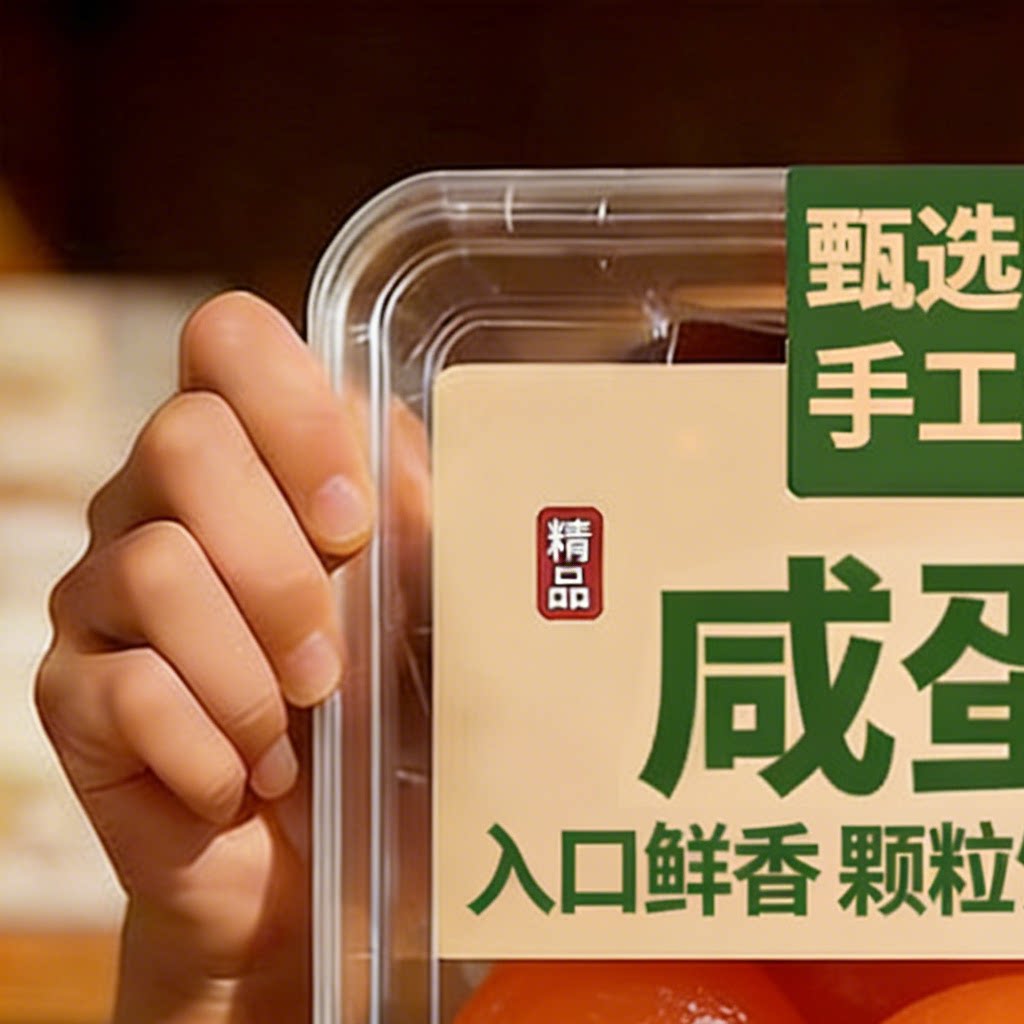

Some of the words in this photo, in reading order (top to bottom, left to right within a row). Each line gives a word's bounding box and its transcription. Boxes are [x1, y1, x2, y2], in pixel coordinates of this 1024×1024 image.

[546, 518, 592, 611] 精品
[467, 822, 821, 917] 入口鲜香
